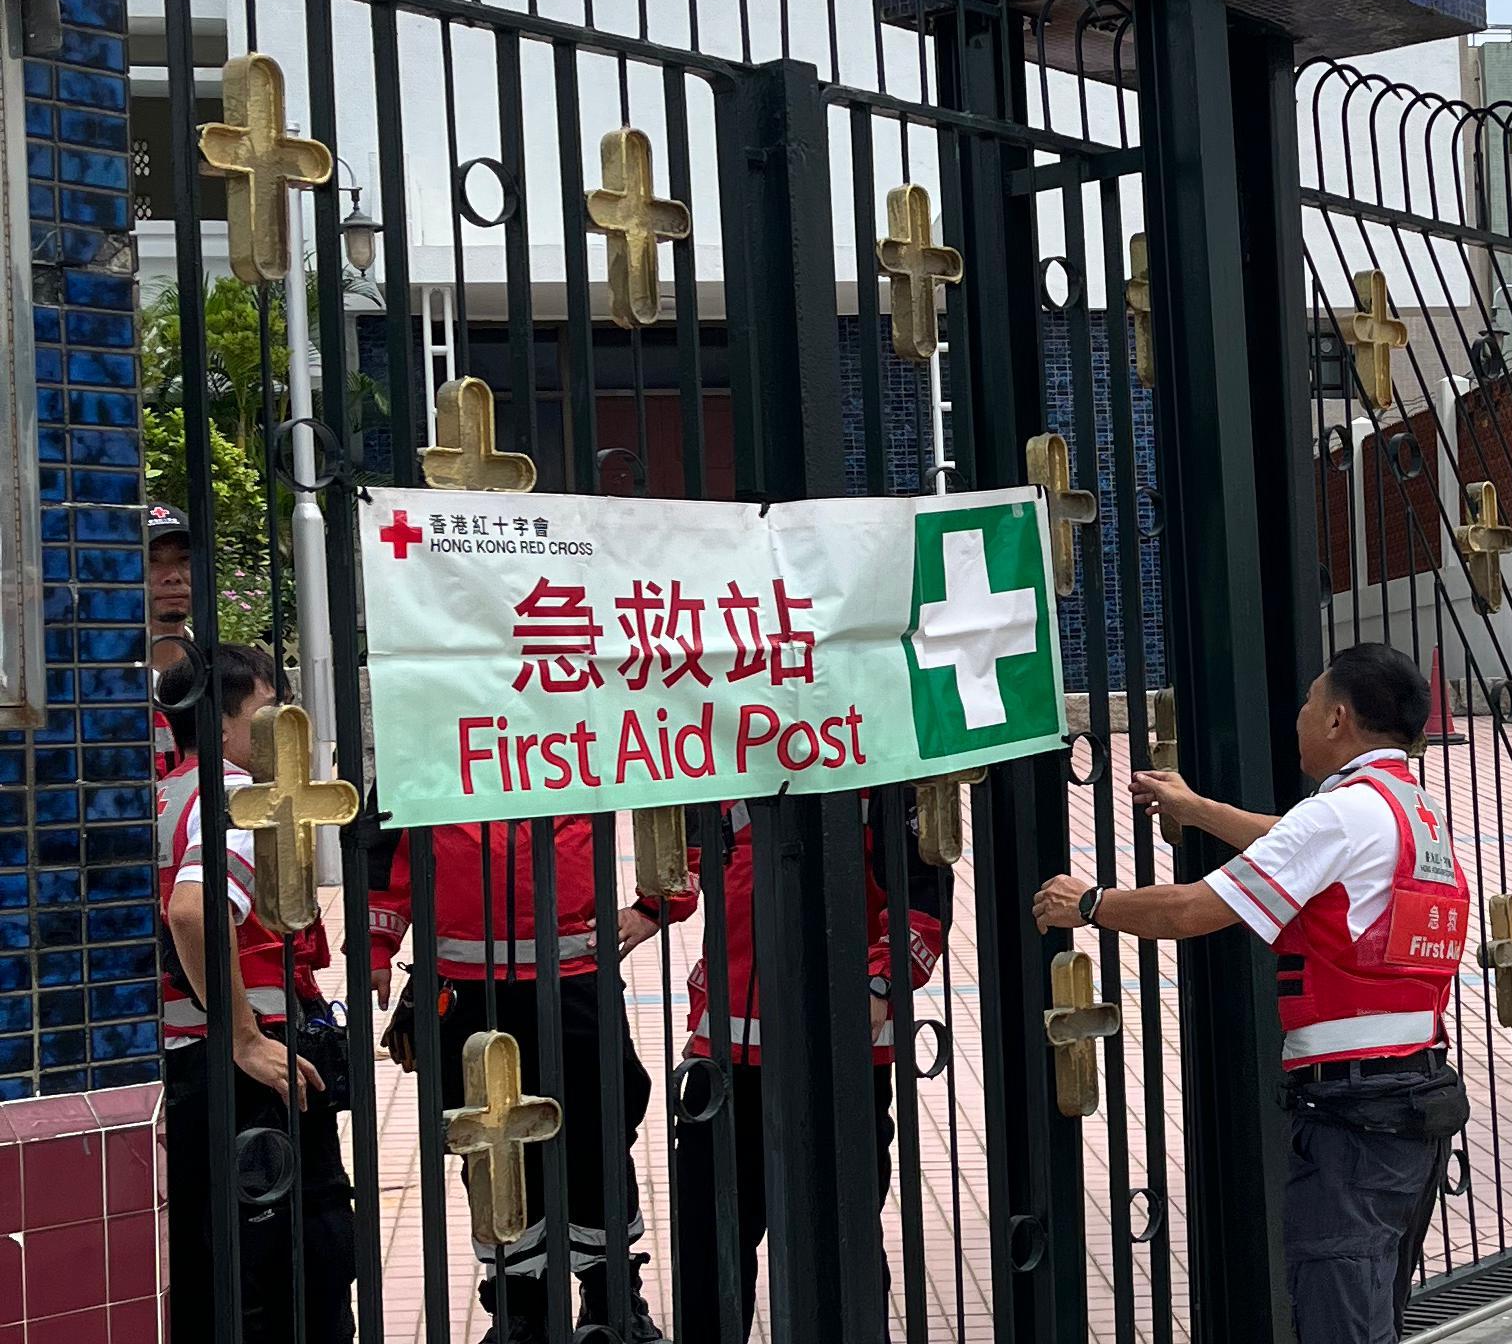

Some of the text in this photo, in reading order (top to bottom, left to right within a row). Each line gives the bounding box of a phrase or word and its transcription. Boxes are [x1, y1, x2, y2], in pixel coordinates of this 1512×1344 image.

[429, 514, 549, 538] 香港紅十字會
[430, 539, 593, 556] HONG KONG RED CROSS
[512, 576, 816, 694] 急救站
[458, 701, 868, 795] First Aid Post
[1409, 935, 1445, 959] First
